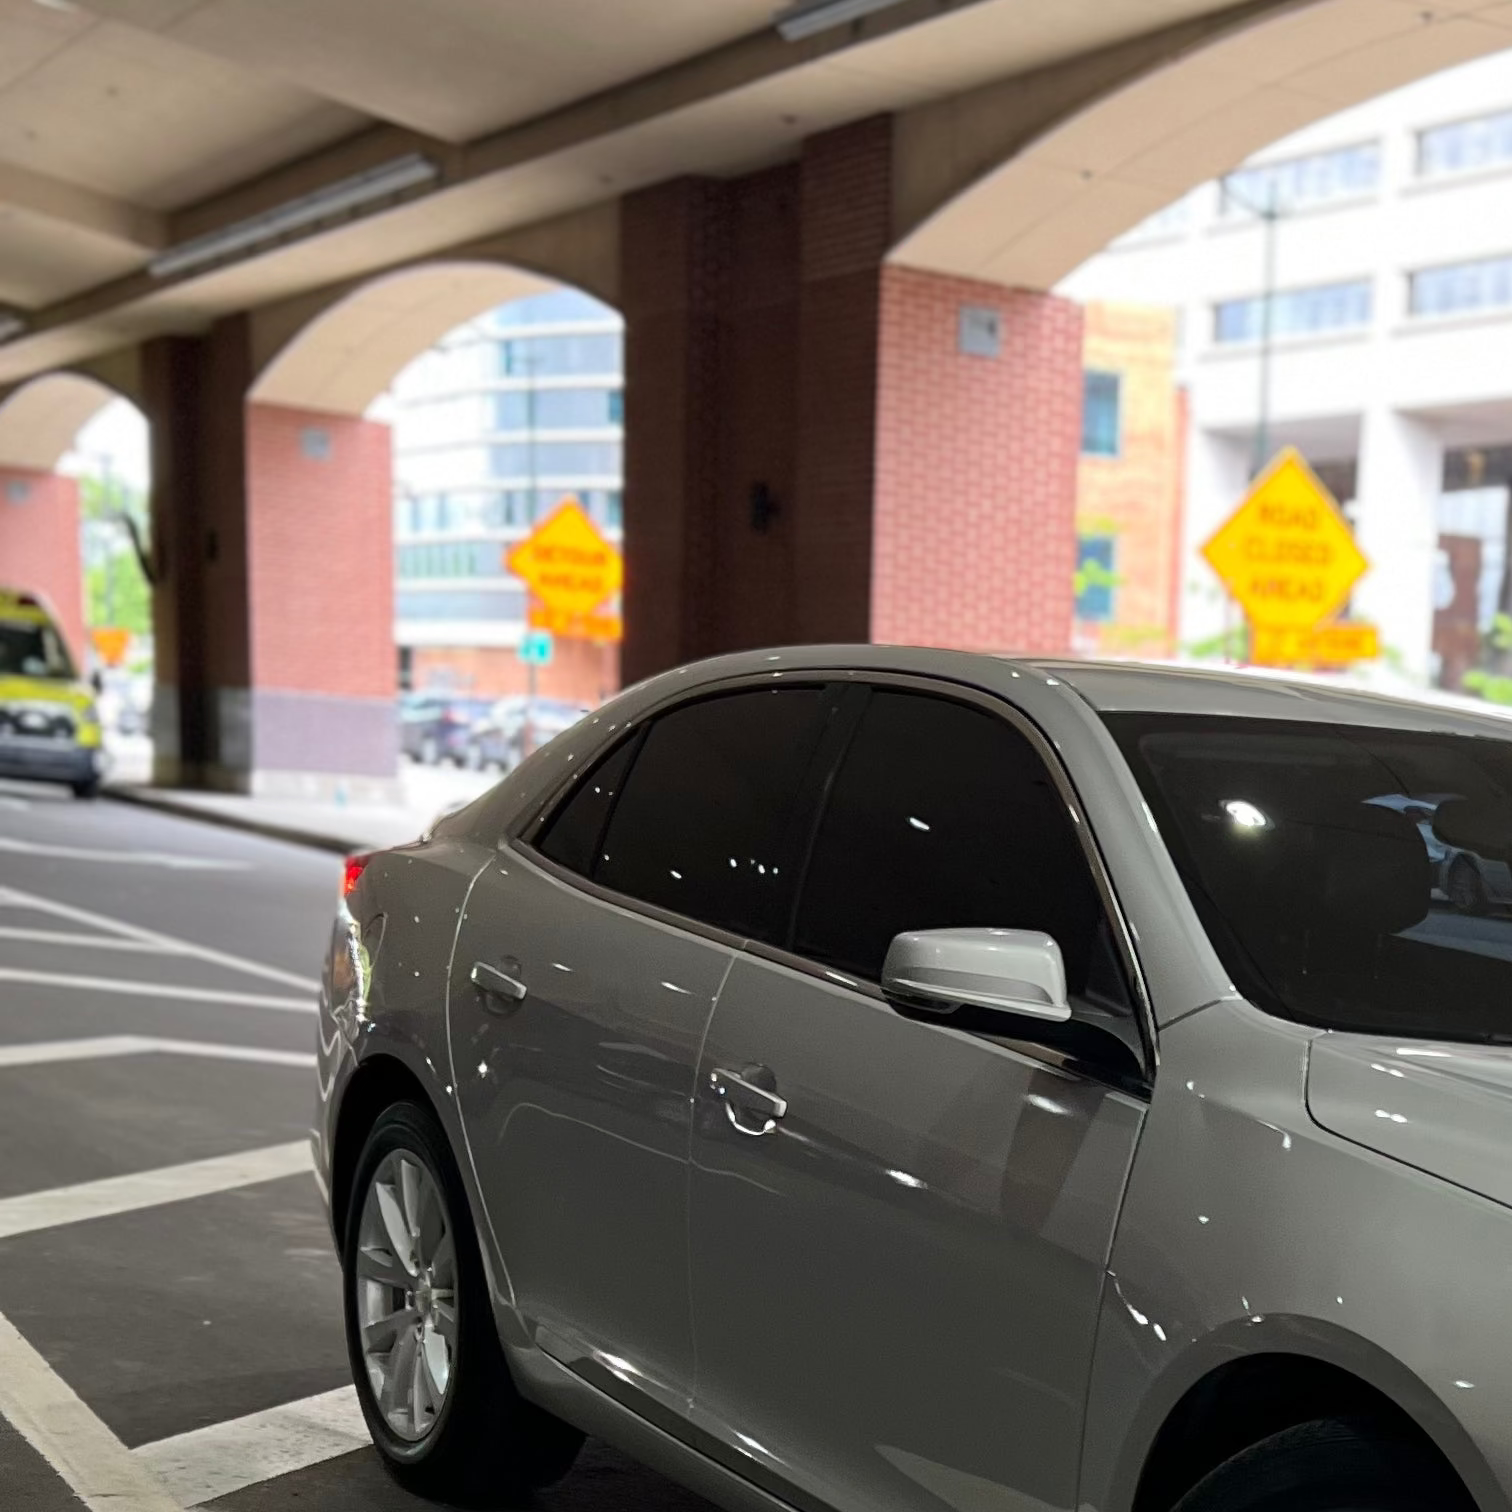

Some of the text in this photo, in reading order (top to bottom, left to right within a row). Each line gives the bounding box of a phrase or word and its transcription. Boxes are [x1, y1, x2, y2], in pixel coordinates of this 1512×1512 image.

[1259, 501, 1319, 532] ROAD
[1242, 536, 1332, 567] CLOSED
[539, 572, 603, 594] AHEAD
[1250, 575, 1323, 604] AHEAD
